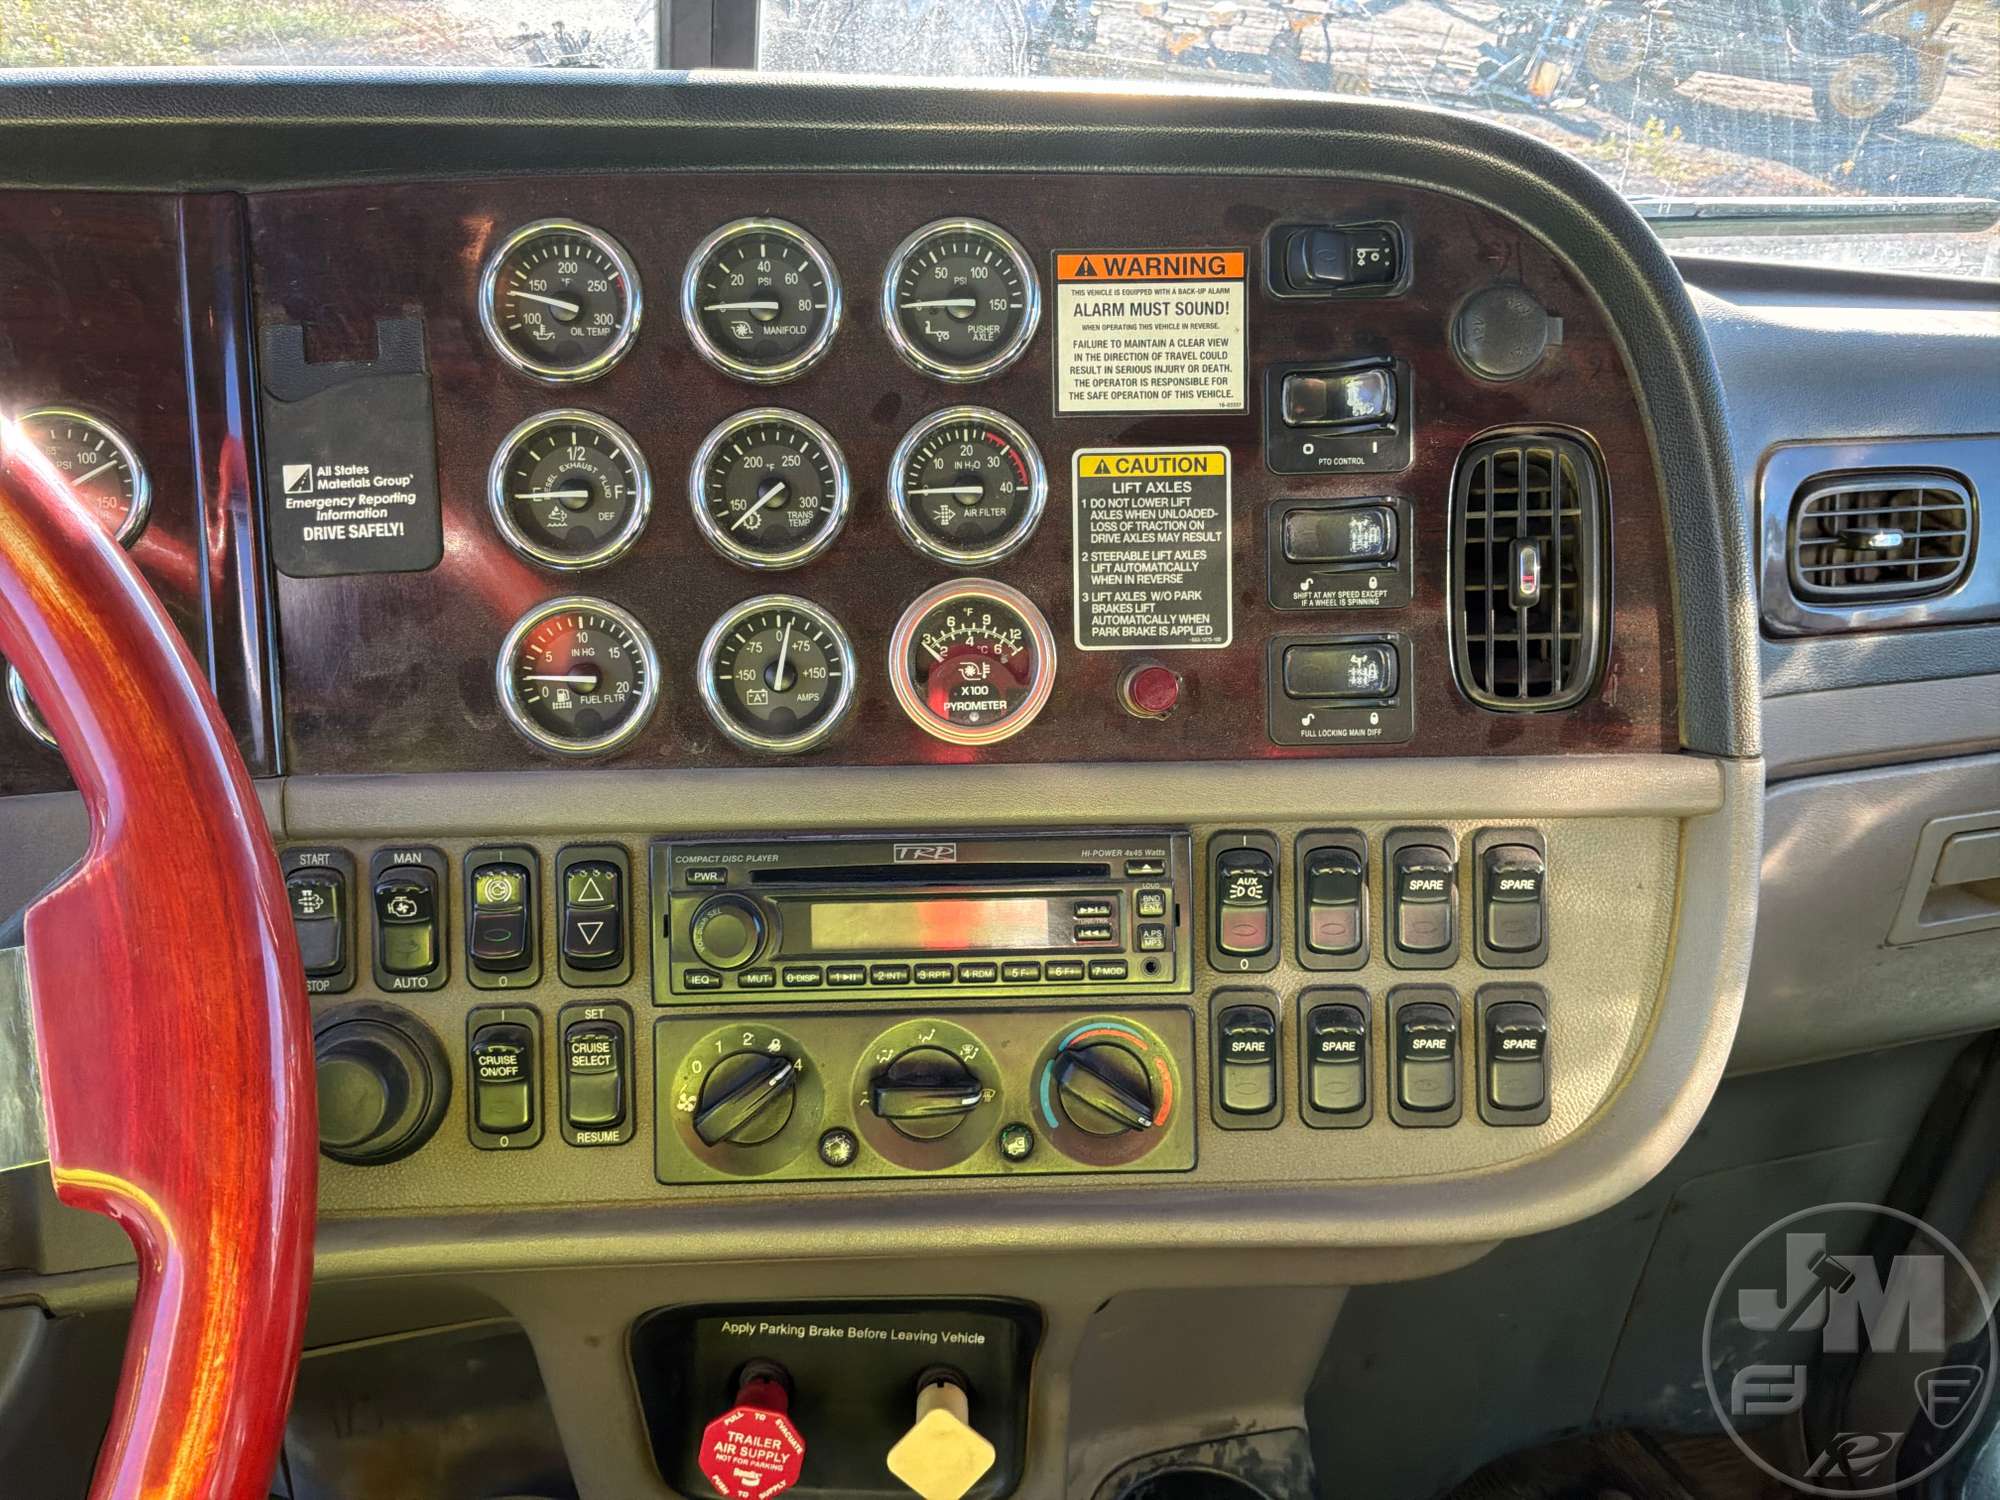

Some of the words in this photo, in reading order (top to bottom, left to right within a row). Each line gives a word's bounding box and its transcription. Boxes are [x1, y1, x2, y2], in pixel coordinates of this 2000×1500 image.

[558, 262, 577, 274] 200
[757, 261, 771, 272] 40
[1104, 256, 1226, 276] WARNING
[785, 273, 798, 284] 60
[935, 268, 948, 279] 50
[971, 267, 988, 279] 100
[731, 274, 744, 285] 20
[758, 278, 772, 286] PSI
[954, 277, 967, 285] PSI
[529, 280, 547, 291] 150
[587, 281, 607, 291] 250
[799, 300, 811, 311] 80
[989, 300, 1007, 310] 150
[1074, 303, 1125, 317] ALARM
[1130, 302, 1170, 316] MUST
[1176, 301, 1229, 315] SOUND!
[523, 313, 541, 324] 100
[594, 314, 613, 325] 300
[571, 328, 585, 336] OIL
[587, 327, 610, 336] TEMP
[764, 326, 806, 334] MANIFOLD
[1073, 340, 1108, 348] FAILURE
[1125, 339, 1166, 347] MAINTAIN
[1178, 338, 1204, 347] CLEAR
[1207, 338, 1228, 346] VIEW
[1104, 353, 1149, 361] DIRECTION
[1166, 352, 1197, 360] TRAVEL
[1200, 351, 1227, 360] COULD
[1070, 366, 1101, 375] RESULT
[1116, 365, 1152, 374] SERIOUS
[1155, 365, 1184, 373] INJURY
[1202, 364, 1232, 373] DEATH.
[1093, 378, 1137, 387] OPERATOR
[1151, 378, 1209, 386] RESPONSIBLE
[1087, 391, 1108, 400] SAFE
[1111, 391, 1159, 399] OPERATION
[1175, 390, 1193, 398] THIS
[1196, 390, 1233, 398] VEHICLE.
[567, 447, 585, 461] 1/2
[960, 445, 973, 456] 20
[77, 452, 96, 464] 100
[744, 457, 763, 468] 200
[782, 456, 800, 466] 250
[934, 458, 944, 469] 10
[987, 457, 1000, 468] 30
[1334, 457, 1365, 465] CONTROL
[317, 466, 331, 477] All
[335, 465, 369, 475] States
[559, 463, 598, 473] EXHAUST
[1116, 457, 1207, 474] CAUTION
[318, 477, 370, 490] Materials
[373, 476, 410, 487] Group
[1000, 482, 1013, 493] 40
[1113, 483, 1142, 494] LIFT
[1146, 482, 1192, 493] AXLES
[96, 497, 117, 508] 150
[286, 496, 356, 509] Emergency
[359, 493, 416, 506] Reporting
[731, 500, 746, 510] 150
[800, 497, 817, 508] 300
[1108, 499, 1130, 508] NOT
[1132, 498, 1168, 507] LOWER
[1171, 497, 1191, 506] LIFT
[317, 508, 388, 521] Information
[788, 511, 813, 519] TRANS
[964, 509, 977, 517] AIR
[980, 508, 1006, 516] FILTER
[1090, 510, 1123, 520] AXLES
[1125, 510, 1156, 519] WHEN
[789, 519, 810, 527] TEMP
[1091, 522, 1117, 531] LOSS
[1135, 521, 1187, 530] TRACTION
[304, 525, 346, 541] DRIVE
[349, 523, 404, 538] SAFELY!
[1091, 534, 1121, 543] DRIVE
[1123, 533, 1155, 543] AXLES
[1158, 532, 1180, 542] MAY
[1182, 532, 1222, 542] RESULT
[1091, 552, 1150, 561] STEERABLE
[1152, 551, 1172, 560] LIFT
[1174, 550, 1207, 560] AXLES
[1091, 563, 1112, 573] LIFT
[1114, 563, 1199, 573] AUTOMATICALLY
[1091, 575, 1122, 584] WHEN
[1137, 574, 1183, 584] REVERSE
[1092, 592, 1112, 602] LIFT
[1114, 592, 1147, 601] AXLES
[1151, 592, 1172, 601] W/O
[1174, 591, 1202, 600] PARK
[1293, 592, 1312, 600] SHIFT
[1092, 604, 1133, 613] BRAKES
[1135, 604, 1155, 613] LIFT
[1092, 615, 1177, 625] AUTOMATICALLY
[1179, 614, 1210, 623] WHEN
[1009, 629, 1021, 639] 12
[1092, 627, 1120, 637] PARK
[1122, 627, 1156, 636] BRAKE
[1170, 626, 1212, 635] APPLIED
[576, 632, 588, 643] 10
[609, 648, 620, 658] 15
[803, 667, 826, 678] +150
[616, 682, 629, 693] 20
[962, 686, 989, 695] X100
[581, 695, 601, 703] FUEL
[604, 694, 625, 702] FLTR
[944, 701, 1007, 711] PYROMETER
[394, 853, 422, 863] MAN
[896, 847, 953, 859] TRP
[300, 854, 330, 865] START
[695, 872, 717, 880] PWR
[1409, 880, 1444, 890] SPARE
[1500, 880, 1535, 890] SPARE
[393, 977, 428, 988] AUTO
[796, 974, 816, 982] DISP
[307, 980, 329, 991] STOP
[585, 1009, 604, 1019] SET
[743, 1032, 754, 1045] 2
[1413, 1039, 1446, 1049] SPARE
[1503, 1039, 1536, 1049] SPARE
[572, 1043, 609, 1053] CRUISE
[1232, 1042, 1265, 1051] SPARE
[1322, 1042, 1355, 1051] SPARE
[479, 1056, 517, 1065] CRUISE
[572, 1056, 611, 1066] SELECT
[793, 1059, 802, 1071] 4
[480, 1067, 519, 1076] ON/OFF
[577, 1132, 619, 1143] RESUME
[722, 1322, 756, 1336] Apply
[760, 1323, 805, 1337] Parking
[809, 1326, 844, 1337] Brake
[848, 1327, 887, 1339] Before
[891, 1330, 937, 1344] Leaving
[941, 1332, 985, 1344] Vehicle
[724, 1412, 744, 1425] PULL
[775, 1419, 803, 1454] EVACUATE
[728, 1431, 781, 1450] TRAILER
[714, 1441, 736, 1454] AIR
[740, 1447, 790, 1463] SUPPLY
[716, 1454, 731, 1462] NOT
[750, 1460, 783, 1471] PARKING
